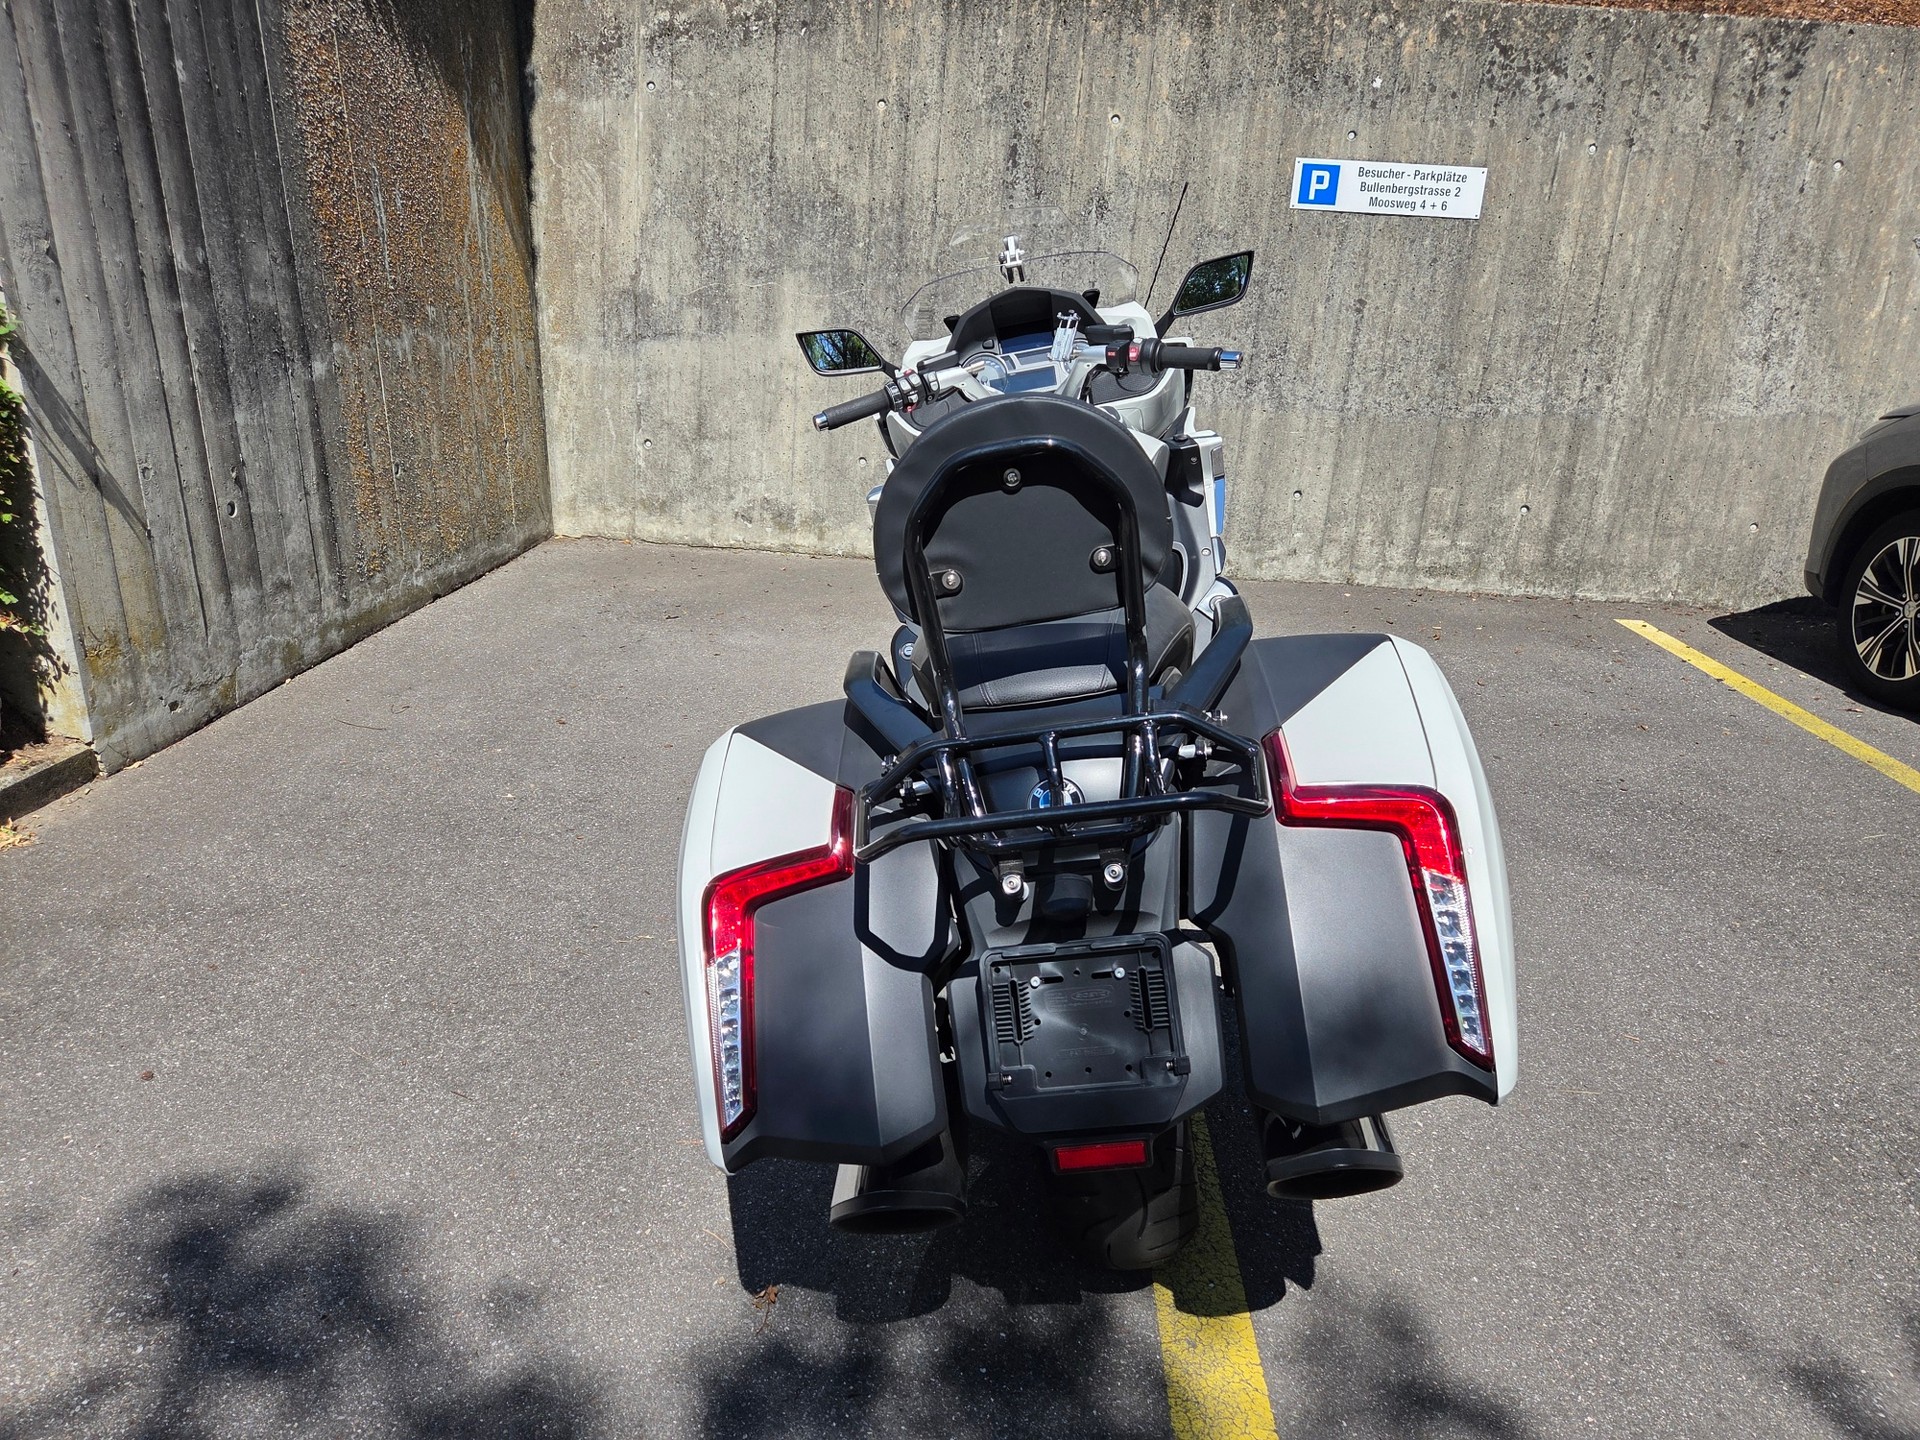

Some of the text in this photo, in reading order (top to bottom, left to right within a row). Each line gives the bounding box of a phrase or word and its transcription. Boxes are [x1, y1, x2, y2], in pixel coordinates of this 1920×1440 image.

[1358, 166, 1406, 179] Besucher
[1413, 169, 1468, 184] Parkplätze
[1308, 170, 1330, 200] P
[1360, 181, 1461, 197] Bullenbergstrasse 2
[1368, 196, 1448, 211] Moosweg 4 + 6
